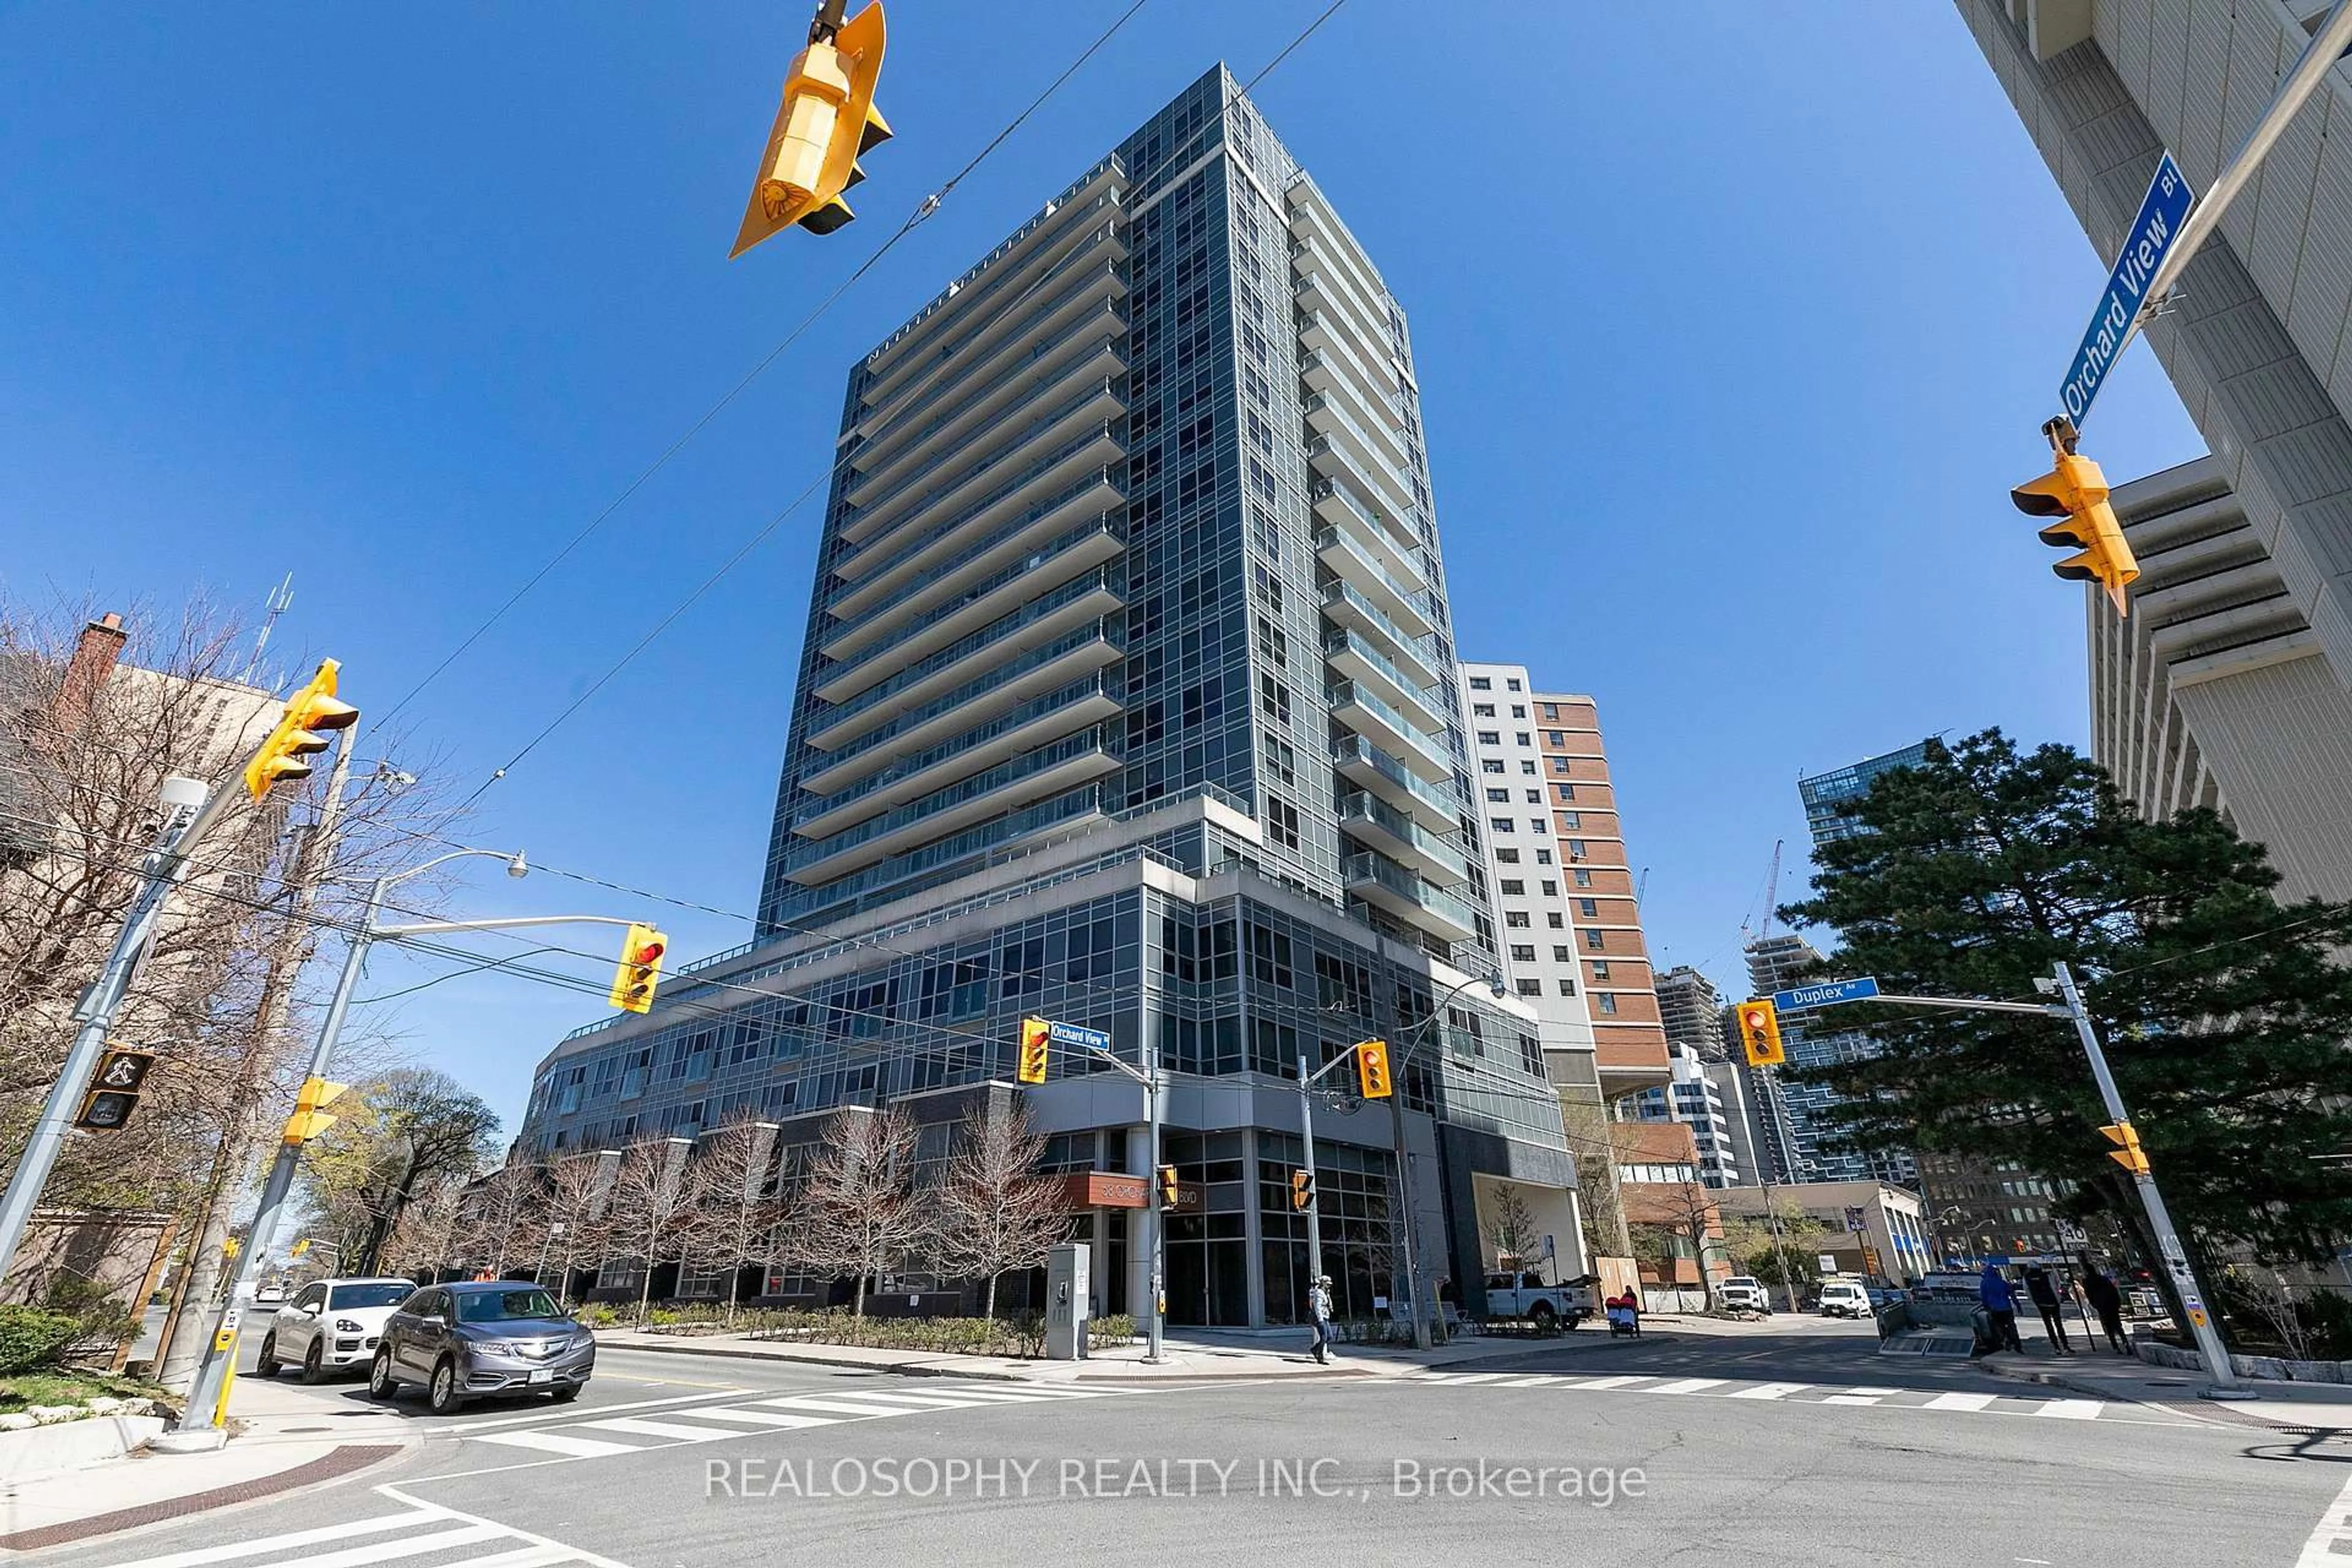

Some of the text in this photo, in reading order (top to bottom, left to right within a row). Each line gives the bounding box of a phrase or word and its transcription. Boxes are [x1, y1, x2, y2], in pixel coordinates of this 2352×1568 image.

[2065, 167, 2178, 417] Orchard View Bl
[1793, 987, 1843, 1004] Duplex
[1053, 1024, 1084, 1042] Orchard
[1085, 1031, 1102, 1046] View
[2065, 1227, 2085, 1240] 40
